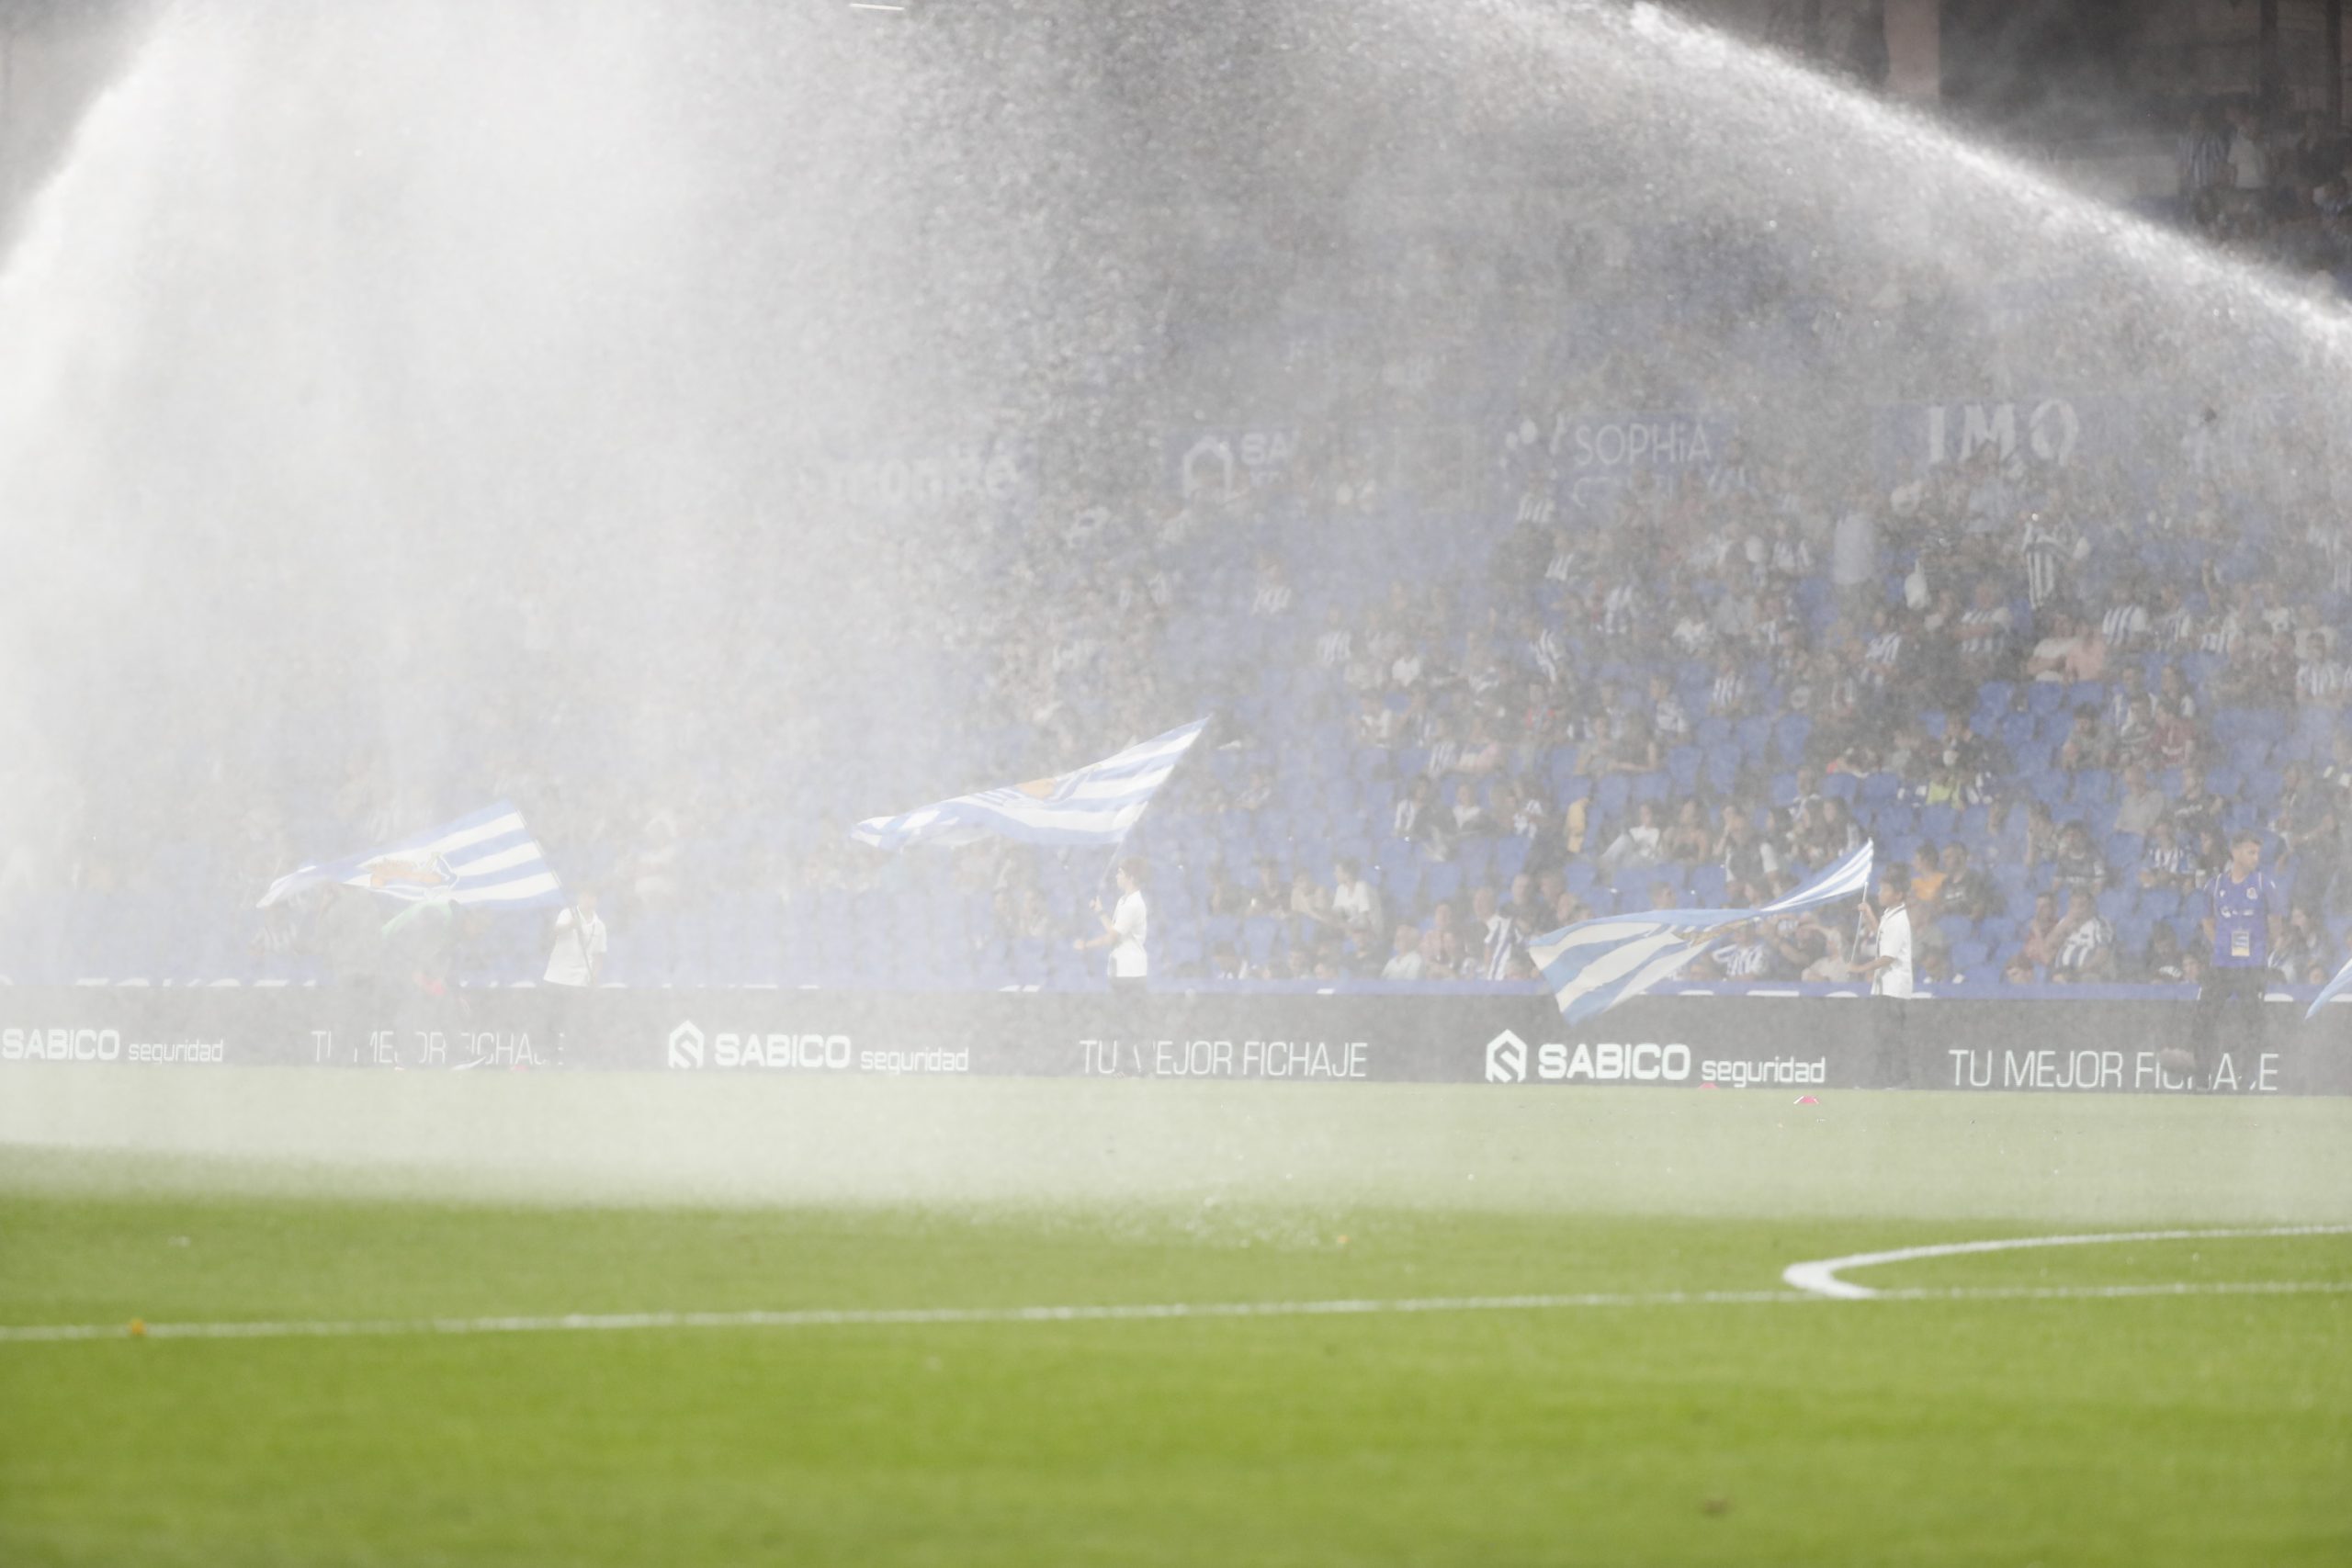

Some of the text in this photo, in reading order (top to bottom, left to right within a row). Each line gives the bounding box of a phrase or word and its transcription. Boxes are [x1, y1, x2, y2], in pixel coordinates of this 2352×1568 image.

[2, 1028, 224, 1065] SABICO seguridad
[714, 1032, 969, 1075] SABICO seguridad
[1079, 1039, 1118, 1074] TU
[1242, 1041, 1369, 1077] FICHAJE
[1537, 1043, 1827, 1089] SABICO seguridad
[1948, 1049, 2280, 1091] TU MEJOR FIAE
